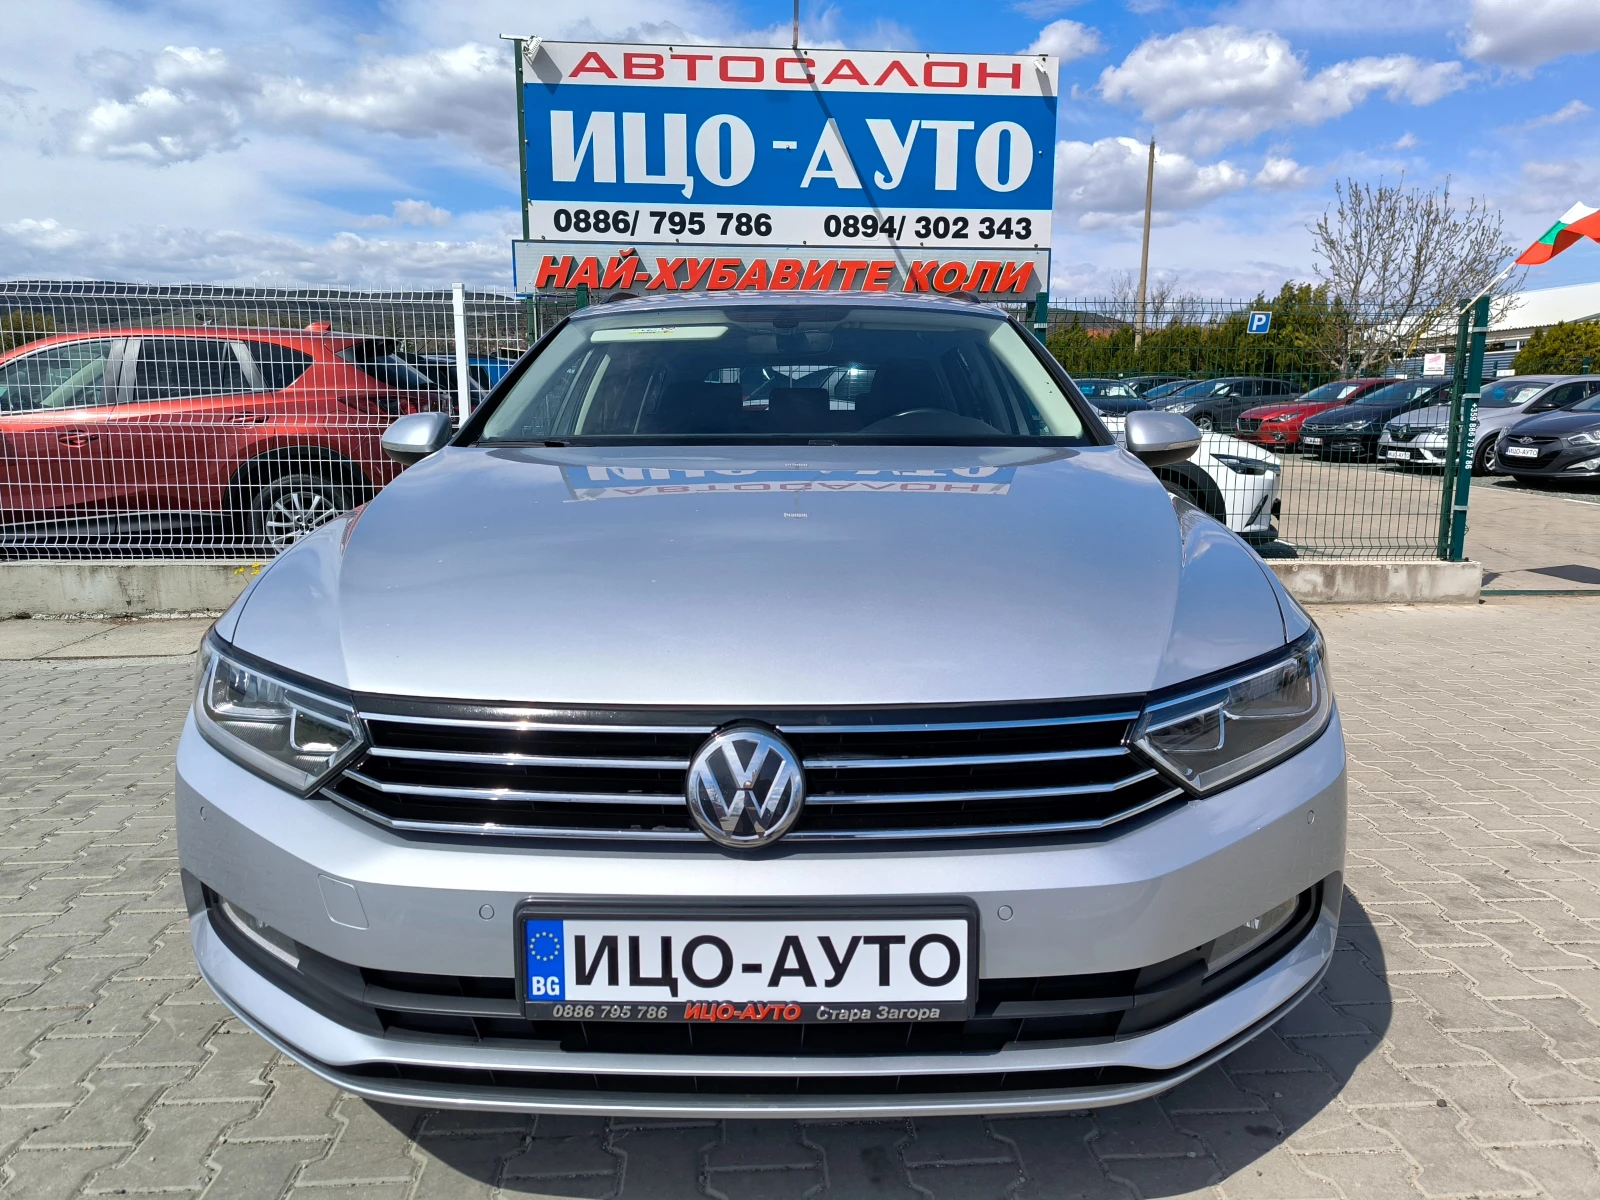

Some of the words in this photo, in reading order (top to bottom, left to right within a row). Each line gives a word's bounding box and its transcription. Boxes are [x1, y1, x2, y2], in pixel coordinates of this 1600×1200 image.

[568, 51, 1021, 90] АВТОСАЛОН
[553, 209, 640, 237] 0886/
[650, 211, 706, 236] 795
[716, 212, 773, 237] 786
[823, 214, 906, 241] 0894/
[914, 215, 970, 240] 302
[978, 216, 1032, 241] 343
[534, 247, 896, 291] НАЙ-ХУБАВИТЕ
[902, 259, 1035, 293] КОЛИ
[1252, 314, 1267, 331] P
[573, 933, 962, 998] ИЦО-АУТО
[531, 976, 560, 996] BG
[552, 1004, 595, 1018] 0886
[600, 1005, 632, 1019] 795
[637, 1006, 668, 1020] 786
[683, 1002, 802, 1022] ИЦО-АУТО
[816, 1005, 872, 1022] Стара
[876, 1005, 941, 1021] Загора
